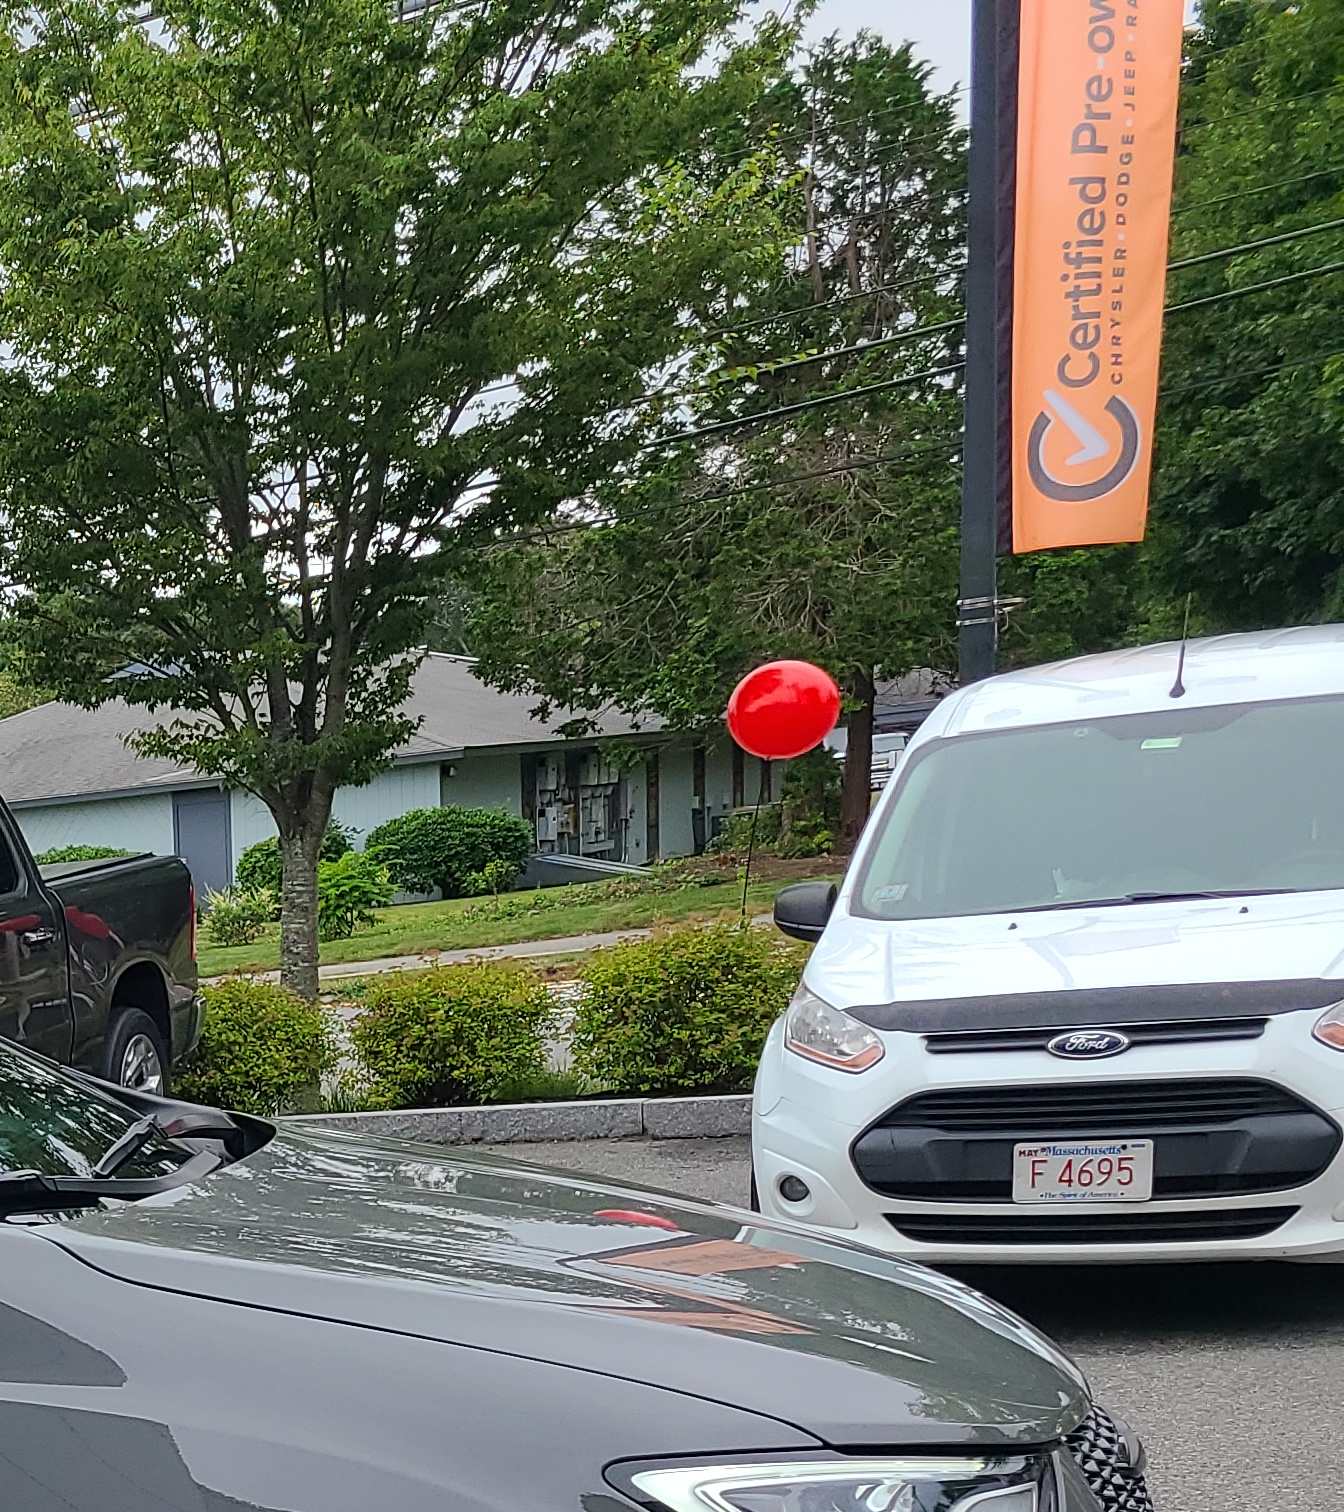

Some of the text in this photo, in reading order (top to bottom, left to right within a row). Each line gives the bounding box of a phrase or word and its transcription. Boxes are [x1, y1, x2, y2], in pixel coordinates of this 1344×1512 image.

[1123, 51, 1136, 111] JEEP
[1115, 134, 1134, 226] DODGE
[1057, 176, 1107, 388] Certified
[1110, 247, 1127, 385] CHRYSLER
[1065, 1034, 1111, 1051] Ford
[1030, 1156, 1135, 1189] F 4695
[1045, 1144, 1122, 1157] Massachusetts
